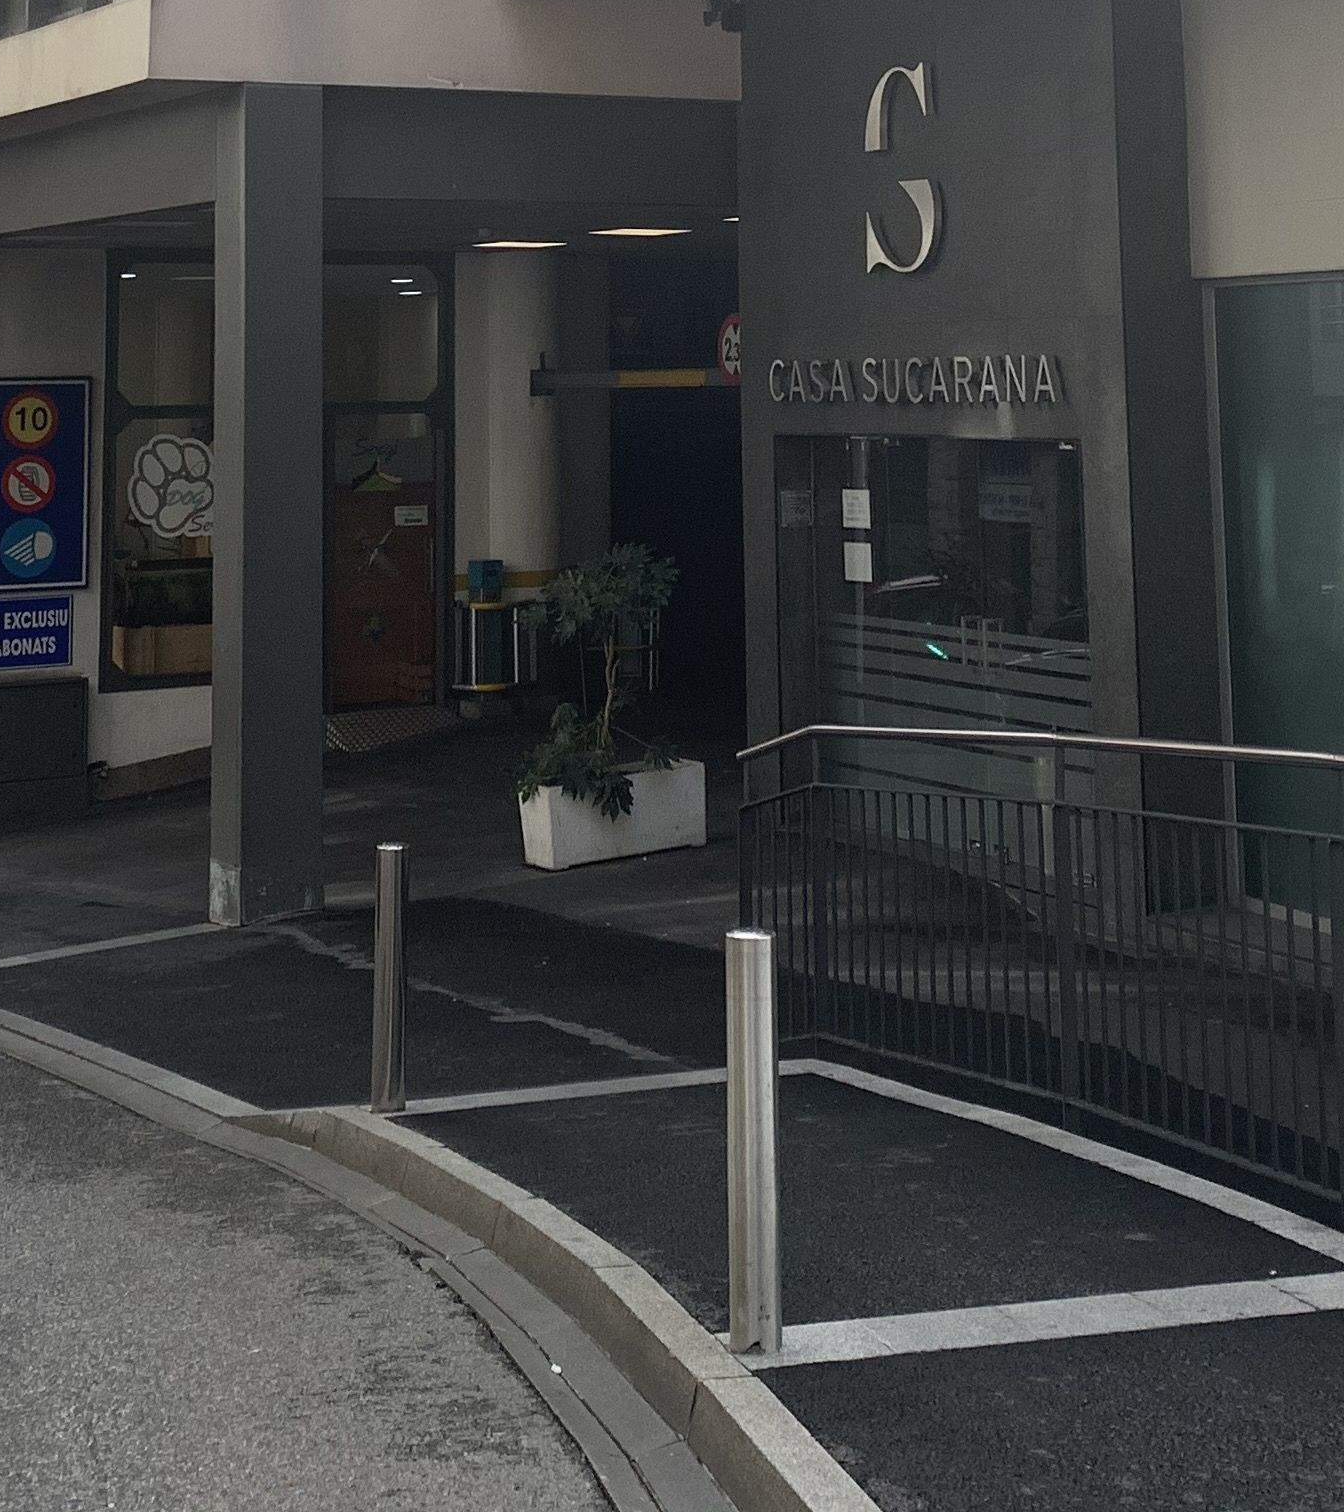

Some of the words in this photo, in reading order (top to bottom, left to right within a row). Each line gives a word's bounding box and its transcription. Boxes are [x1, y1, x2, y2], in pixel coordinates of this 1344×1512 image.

[769, 358, 848, 403] CASA
[862, 354, 1056, 403] SUCARANA
[15, 406, 49, 432] 10
[4, 608, 69, 631] EXCLUSIU
